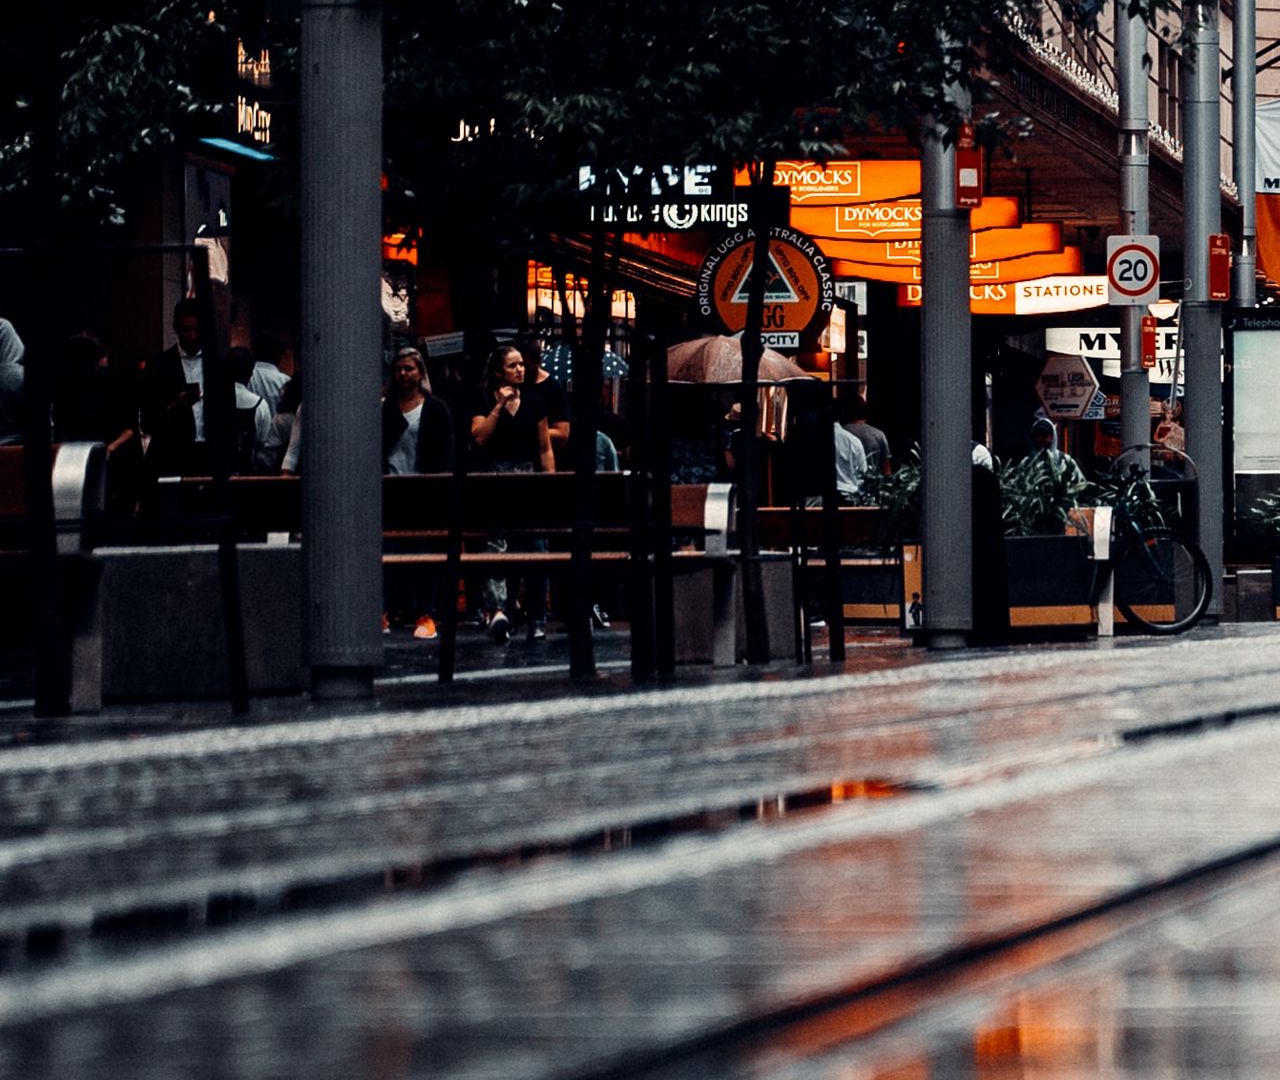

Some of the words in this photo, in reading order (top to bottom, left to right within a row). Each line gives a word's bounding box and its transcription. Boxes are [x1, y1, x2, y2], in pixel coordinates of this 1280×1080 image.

[844, 207, 922, 221] DYMOCKS
[699, 256, 720, 315] ORIGINAL
[717, 231, 744, 254] UGG
[747, 227, 814, 257] ATRALIA
[813, 255, 833, 312] CLASSIC
[1118, 259, 1148, 282] 20
[907, 285, 1007, 301] DCKS
[1023, 285, 1104, 298] STATIONE
[761, 305, 786, 329] GG
